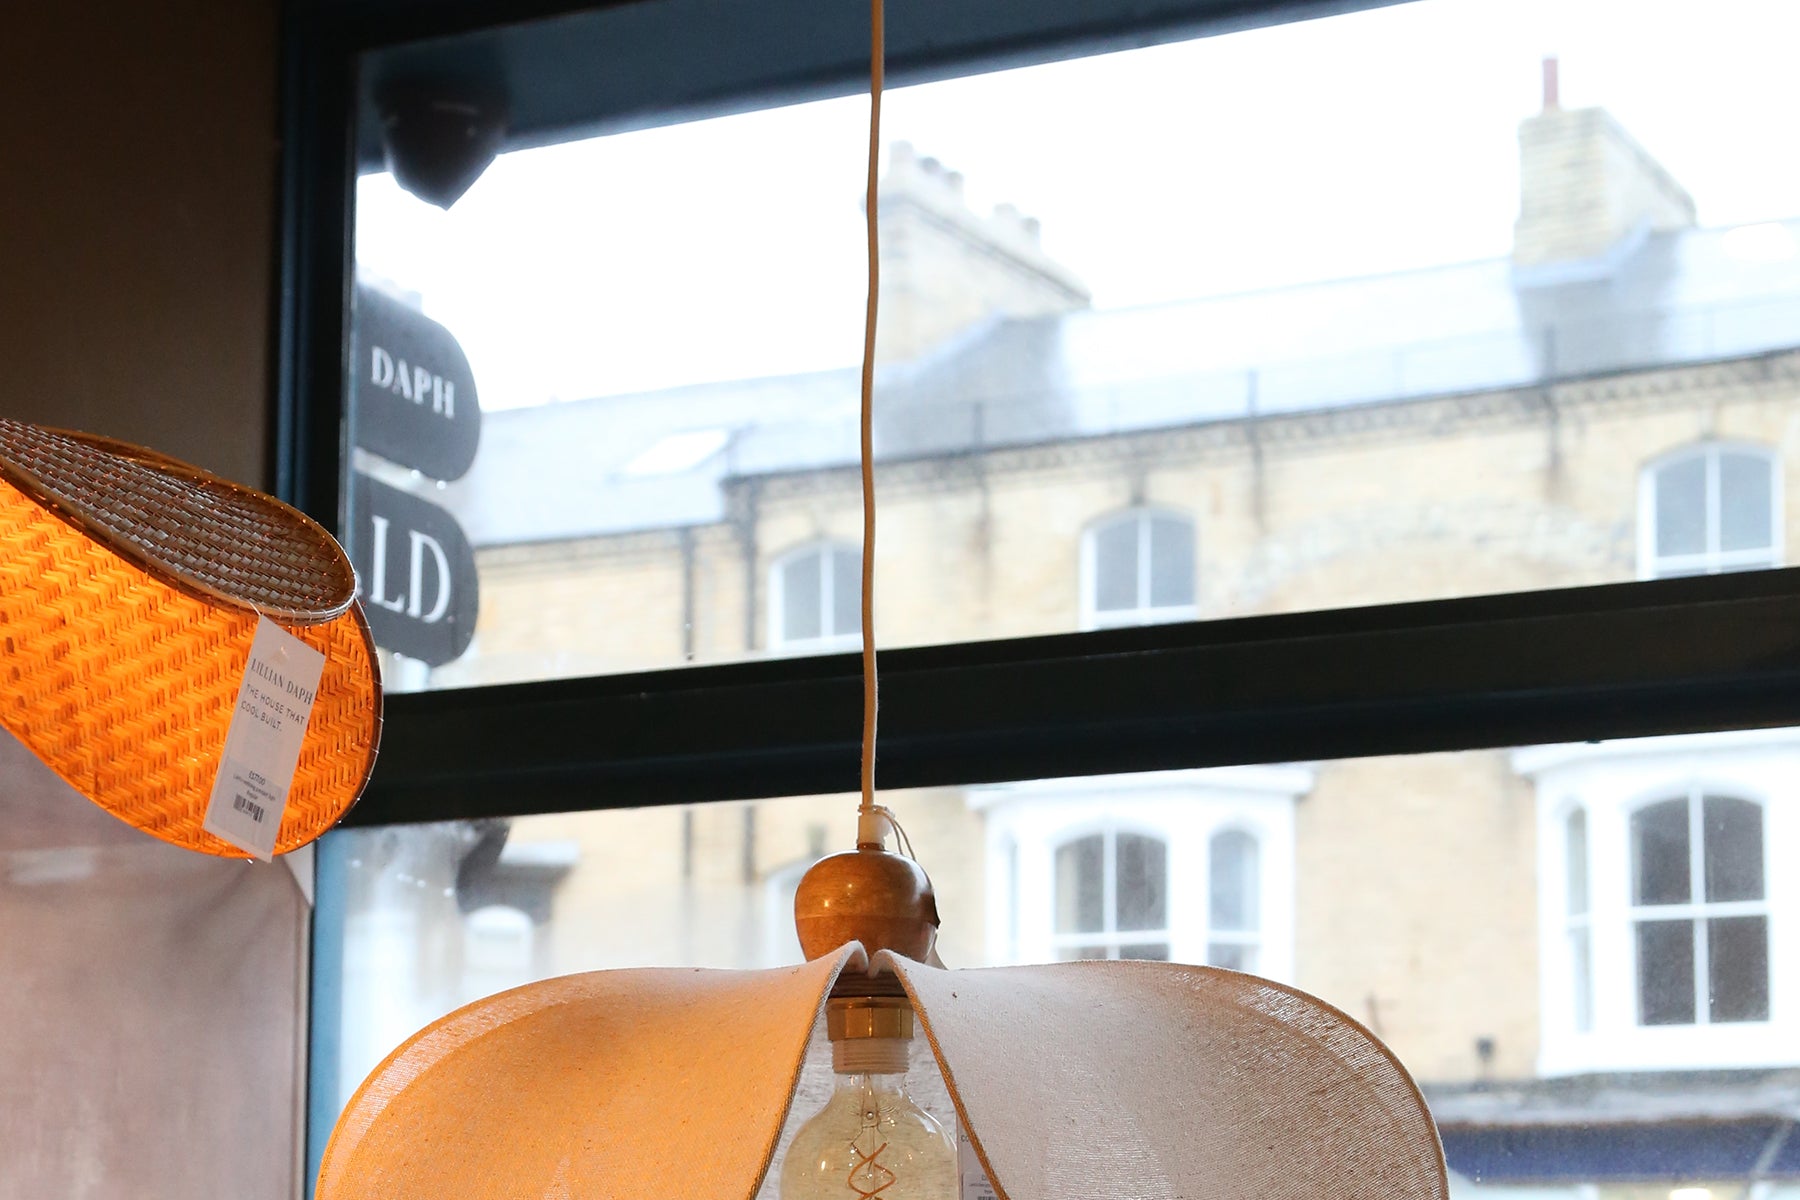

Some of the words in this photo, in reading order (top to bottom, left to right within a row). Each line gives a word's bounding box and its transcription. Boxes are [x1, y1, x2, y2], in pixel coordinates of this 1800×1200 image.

[371, 345, 455, 419] DAPH
[369, 515, 451, 624] LD
[247, 683, 259, 699] THE
[260, 693, 284, 714] HOUSE
[286, 707, 305, 725] THAT
[251, 658, 285, 688] LILLIAN
[286, 680, 313, 705] DAPH
[241, 700, 259, 719] COOL
